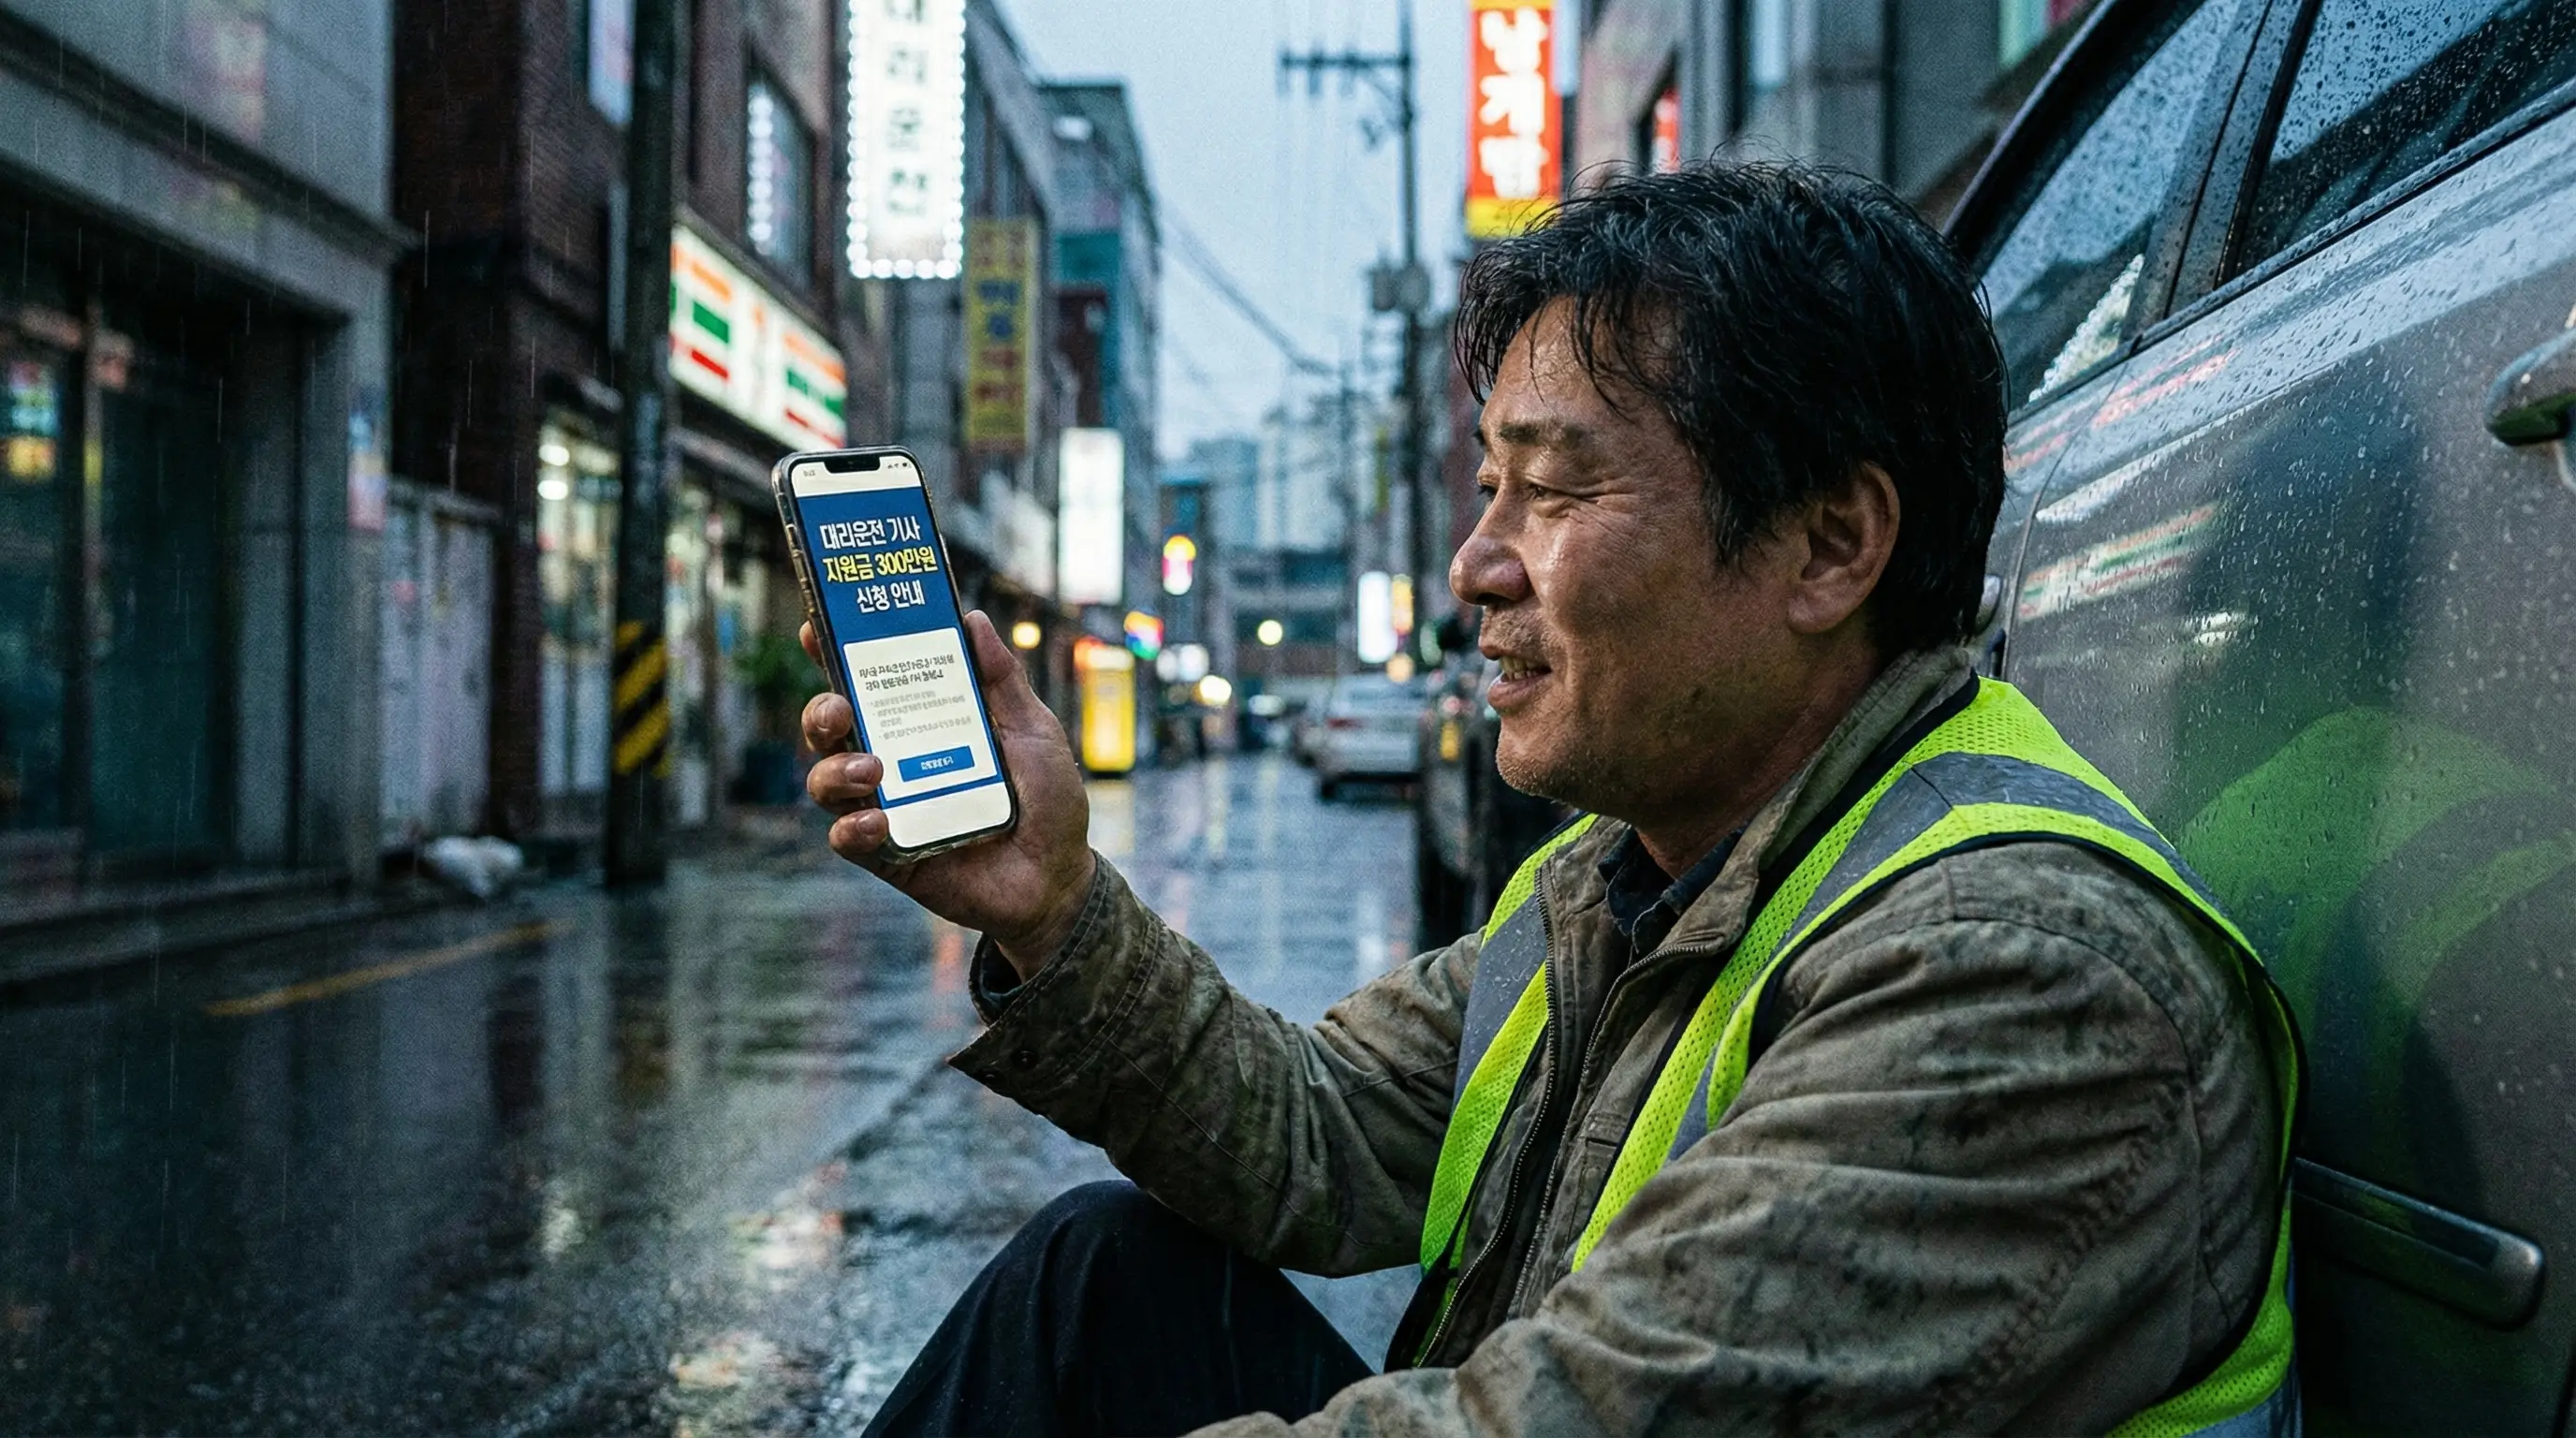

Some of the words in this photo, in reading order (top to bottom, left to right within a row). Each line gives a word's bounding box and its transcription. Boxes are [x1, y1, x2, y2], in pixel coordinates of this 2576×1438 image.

[819, 519, 887, 550] 대리운전
[886, 516, 921, 542] 기사
[822, 553, 875, 583] 지원금
[874, 546, 939, 576] 300만원
[856, 584, 890, 613] 신청
[890, 580, 926, 609] 안내
